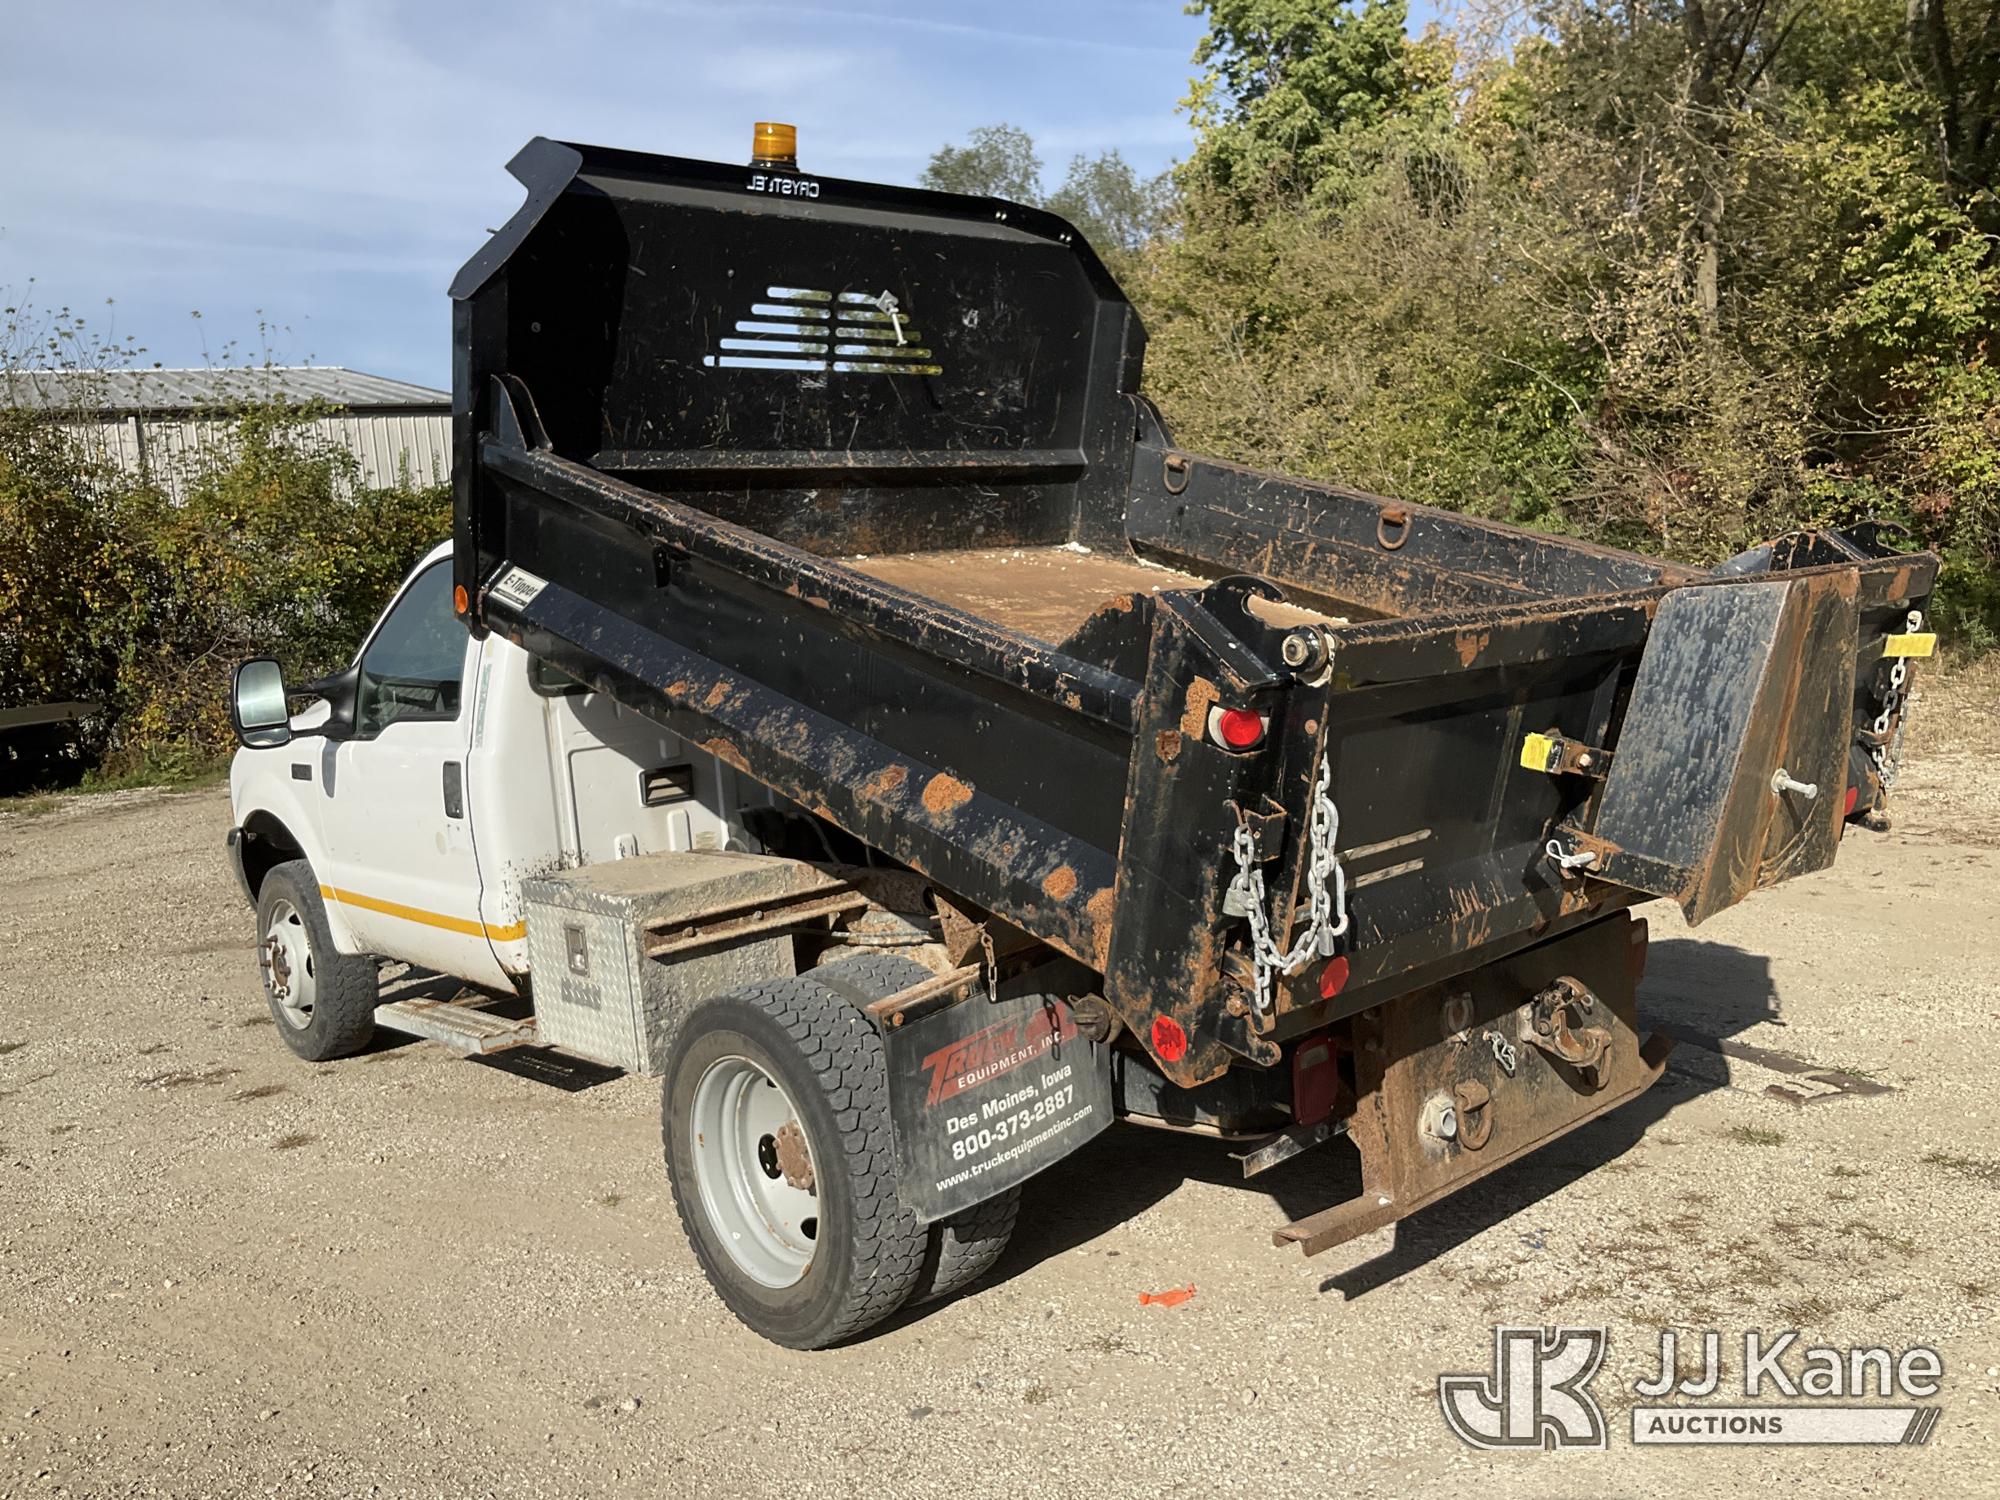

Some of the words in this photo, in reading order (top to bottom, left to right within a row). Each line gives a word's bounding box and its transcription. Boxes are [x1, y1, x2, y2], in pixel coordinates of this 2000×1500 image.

[504, 573, 538, 597] E-Tipper
[946, 1112, 978, 1135] Des
[981, 1087, 1039, 1120] Moines,
[1041, 1064, 1072, 1090] Iowa
[957, 1046, 1038, 1089] EQUIPMENT,
[935, 1103, 1093, 1192] www.truckequipmentinc.com
[951, 1084, 1074, 1161] 800-373-2887
